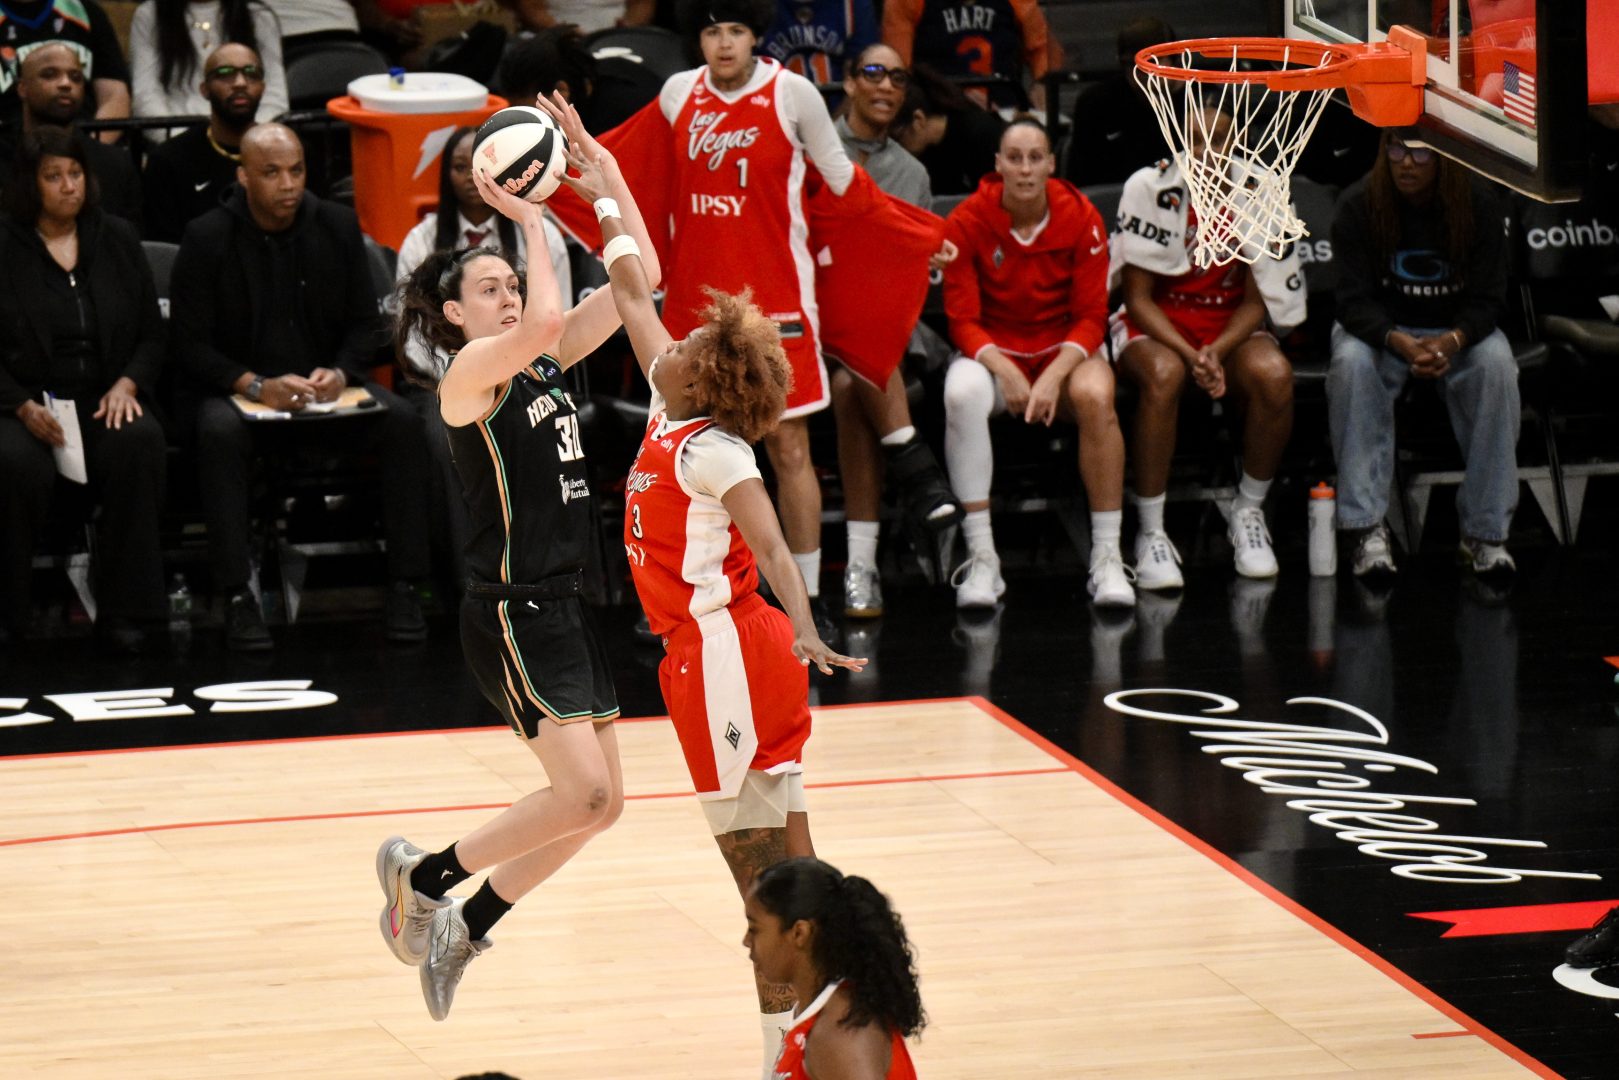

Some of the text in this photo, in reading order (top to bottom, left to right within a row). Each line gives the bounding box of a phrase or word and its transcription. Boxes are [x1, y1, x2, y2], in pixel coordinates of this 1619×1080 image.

[942, 5, 996, 34] HART
[689, 109, 717, 134] Las
[688, 111, 761, 171] Vegas
[501, 158, 545, 195] ilson
[736, 157, 749, 188] 1
[691, 193, 747, 216] IPSY
[1527, 218, 1619, 249] coinb
[526, 393, 558, 428] NEW
[555, 413, 585, 462] 30
[660, 438, 675, 453] ally
[632, 503, 644, 539] 3
